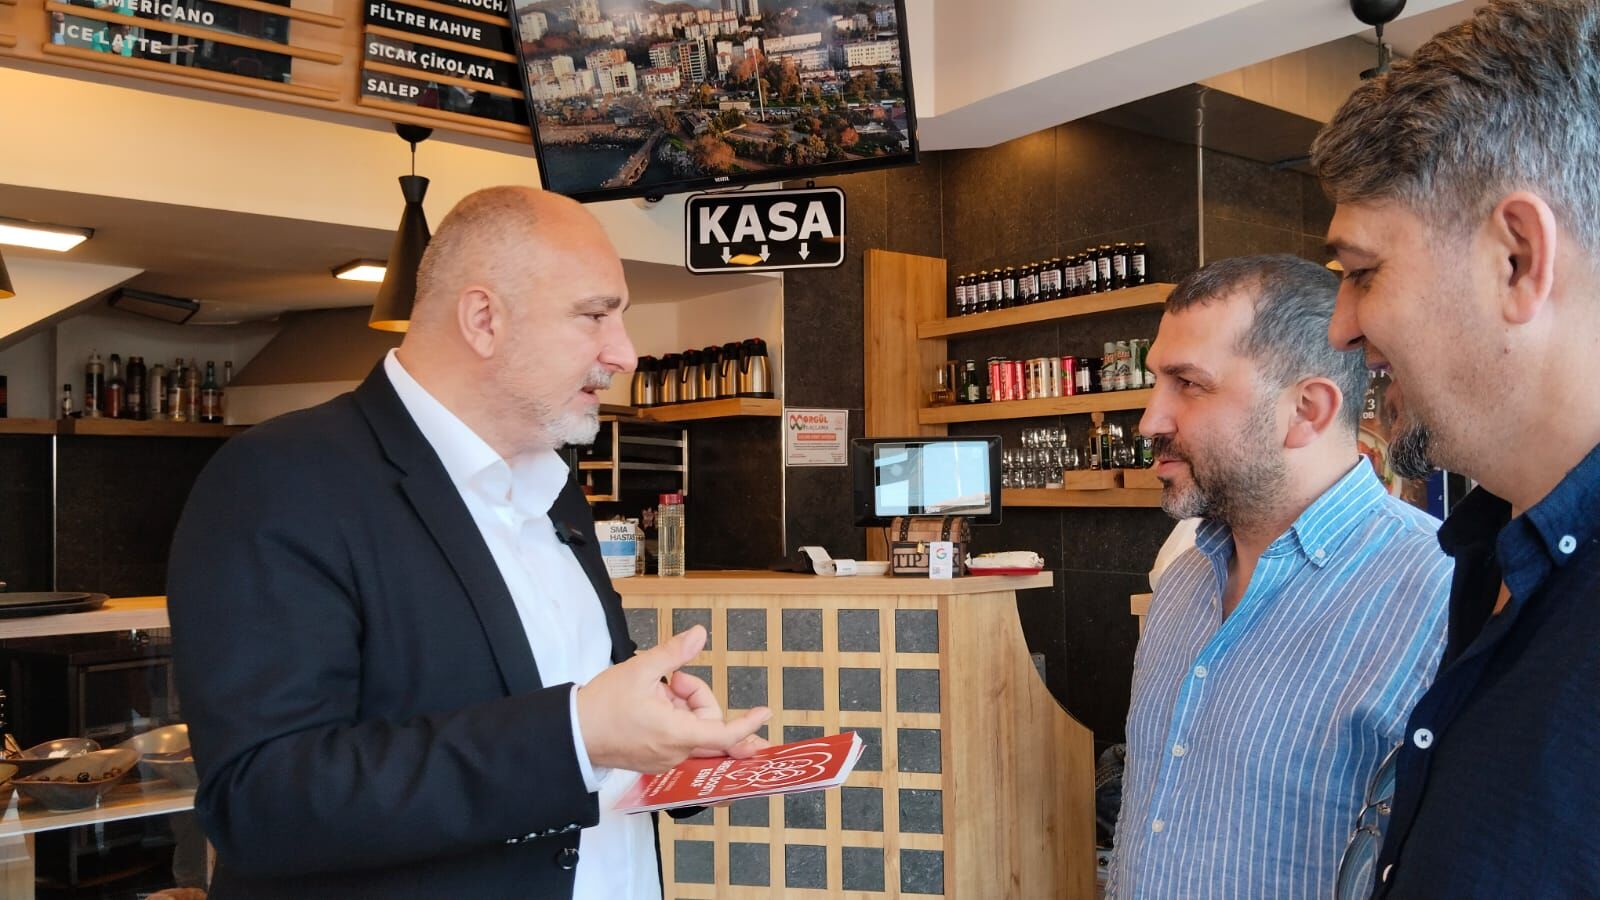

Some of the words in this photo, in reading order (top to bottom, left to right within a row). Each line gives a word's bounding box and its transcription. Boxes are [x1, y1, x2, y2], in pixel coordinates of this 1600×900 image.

[370, 4, 426, 28] FİLTRE
[429, 18, 482, 41] KAHVE
[99, 31, 162, 54] LATTE
[369, 42, 417, 63] SICAK
[420, 52, 495, 80] ÇİKOLATA
[367, 79, 420, 98] SALEP
[700, 201, 834, 245] KASA
